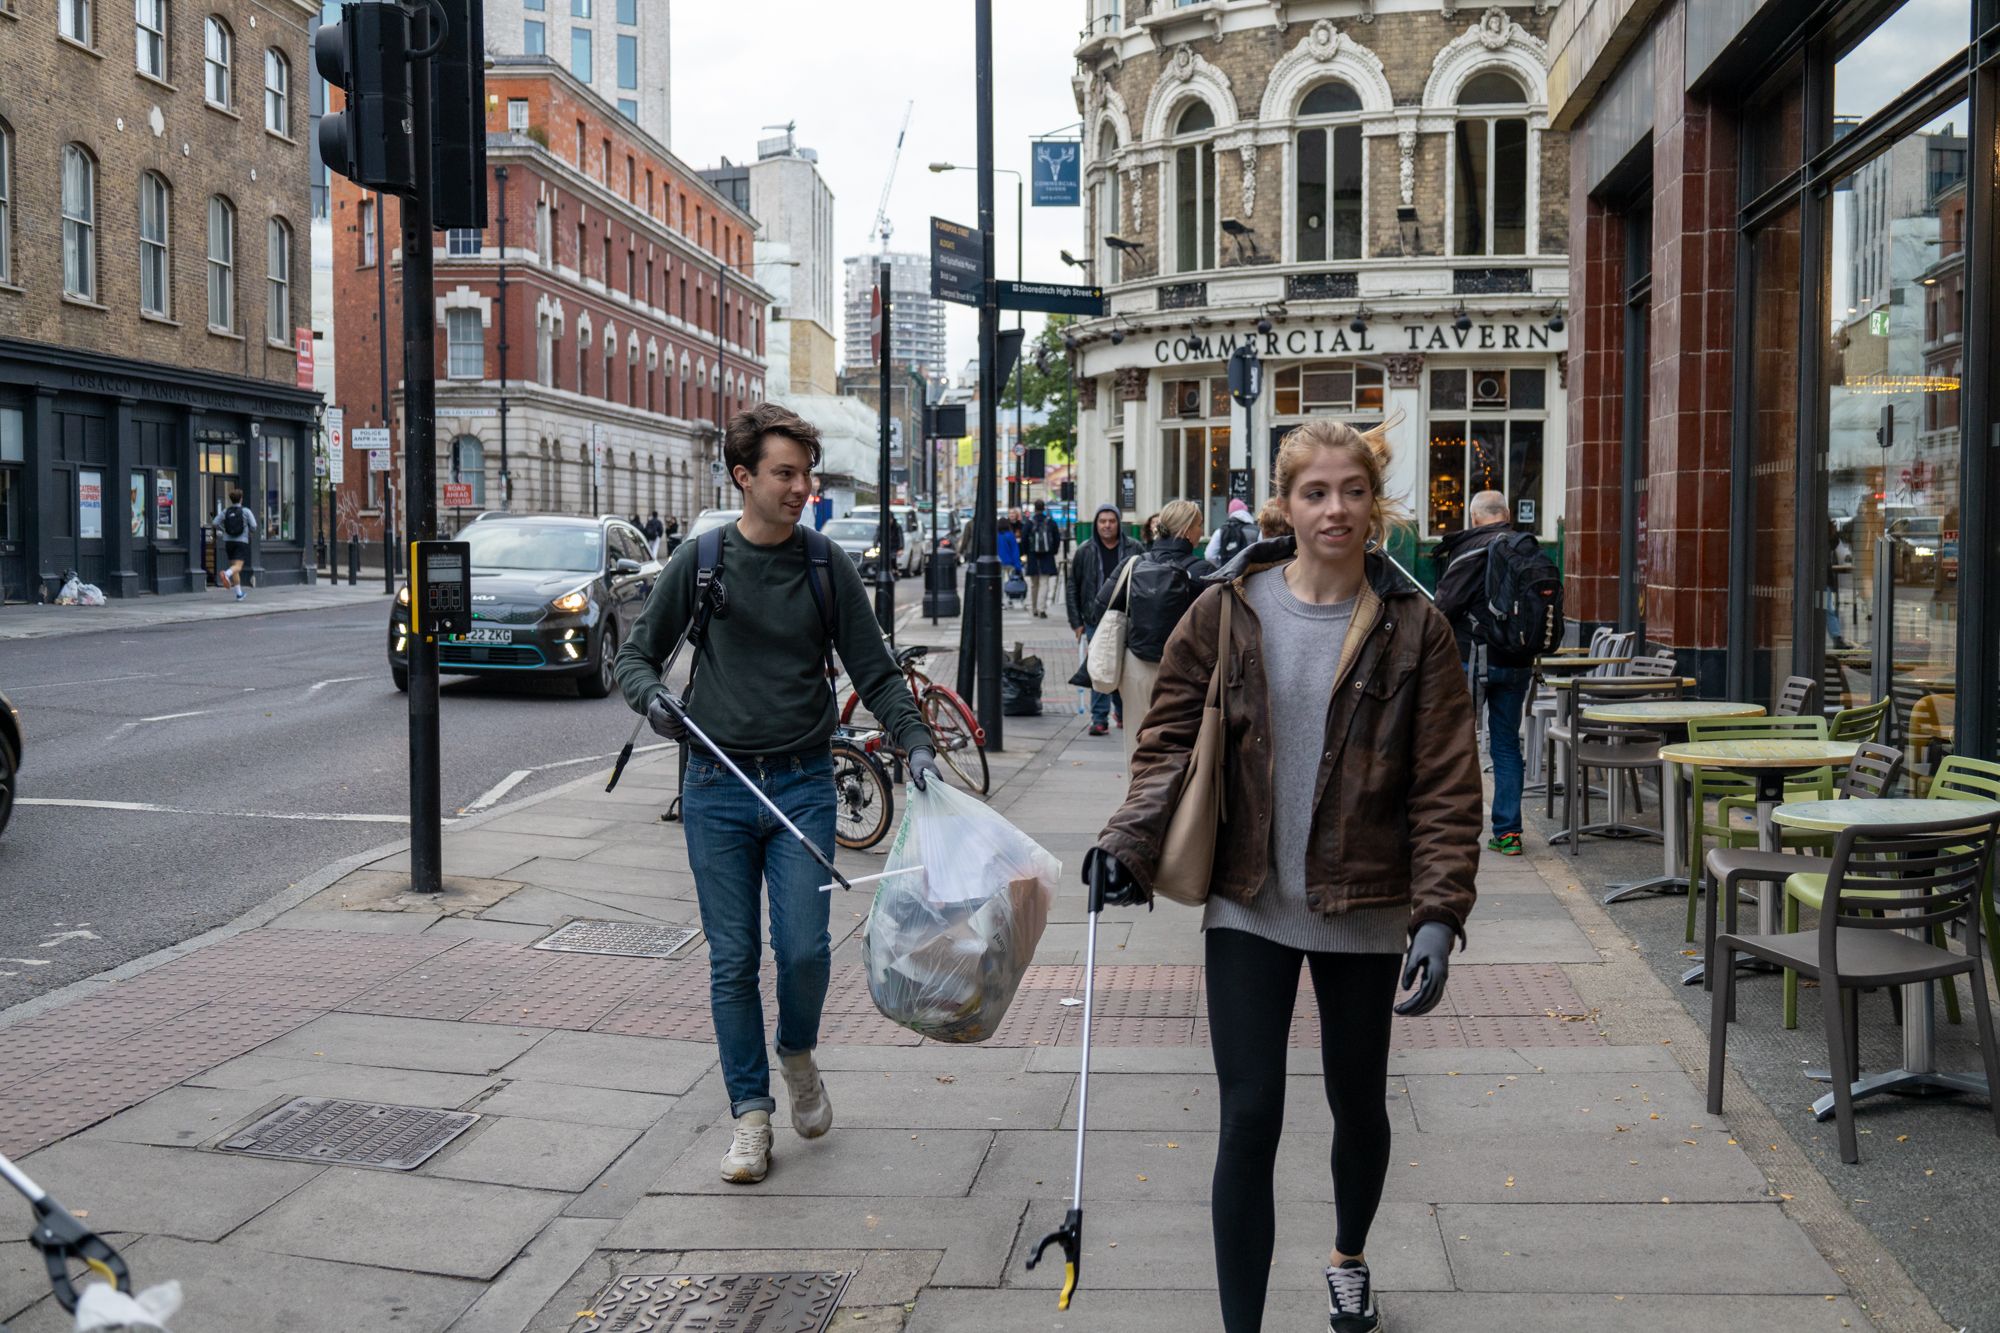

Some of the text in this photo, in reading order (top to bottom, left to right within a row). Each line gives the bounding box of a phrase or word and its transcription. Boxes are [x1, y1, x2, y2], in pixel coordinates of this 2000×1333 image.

[1020, 285, 1092, 297] Shoreditch High Street
[1155, 324, 1551, 363] COMMERCIAL TAVERN
[488, 630, 511, 641] ZKG
